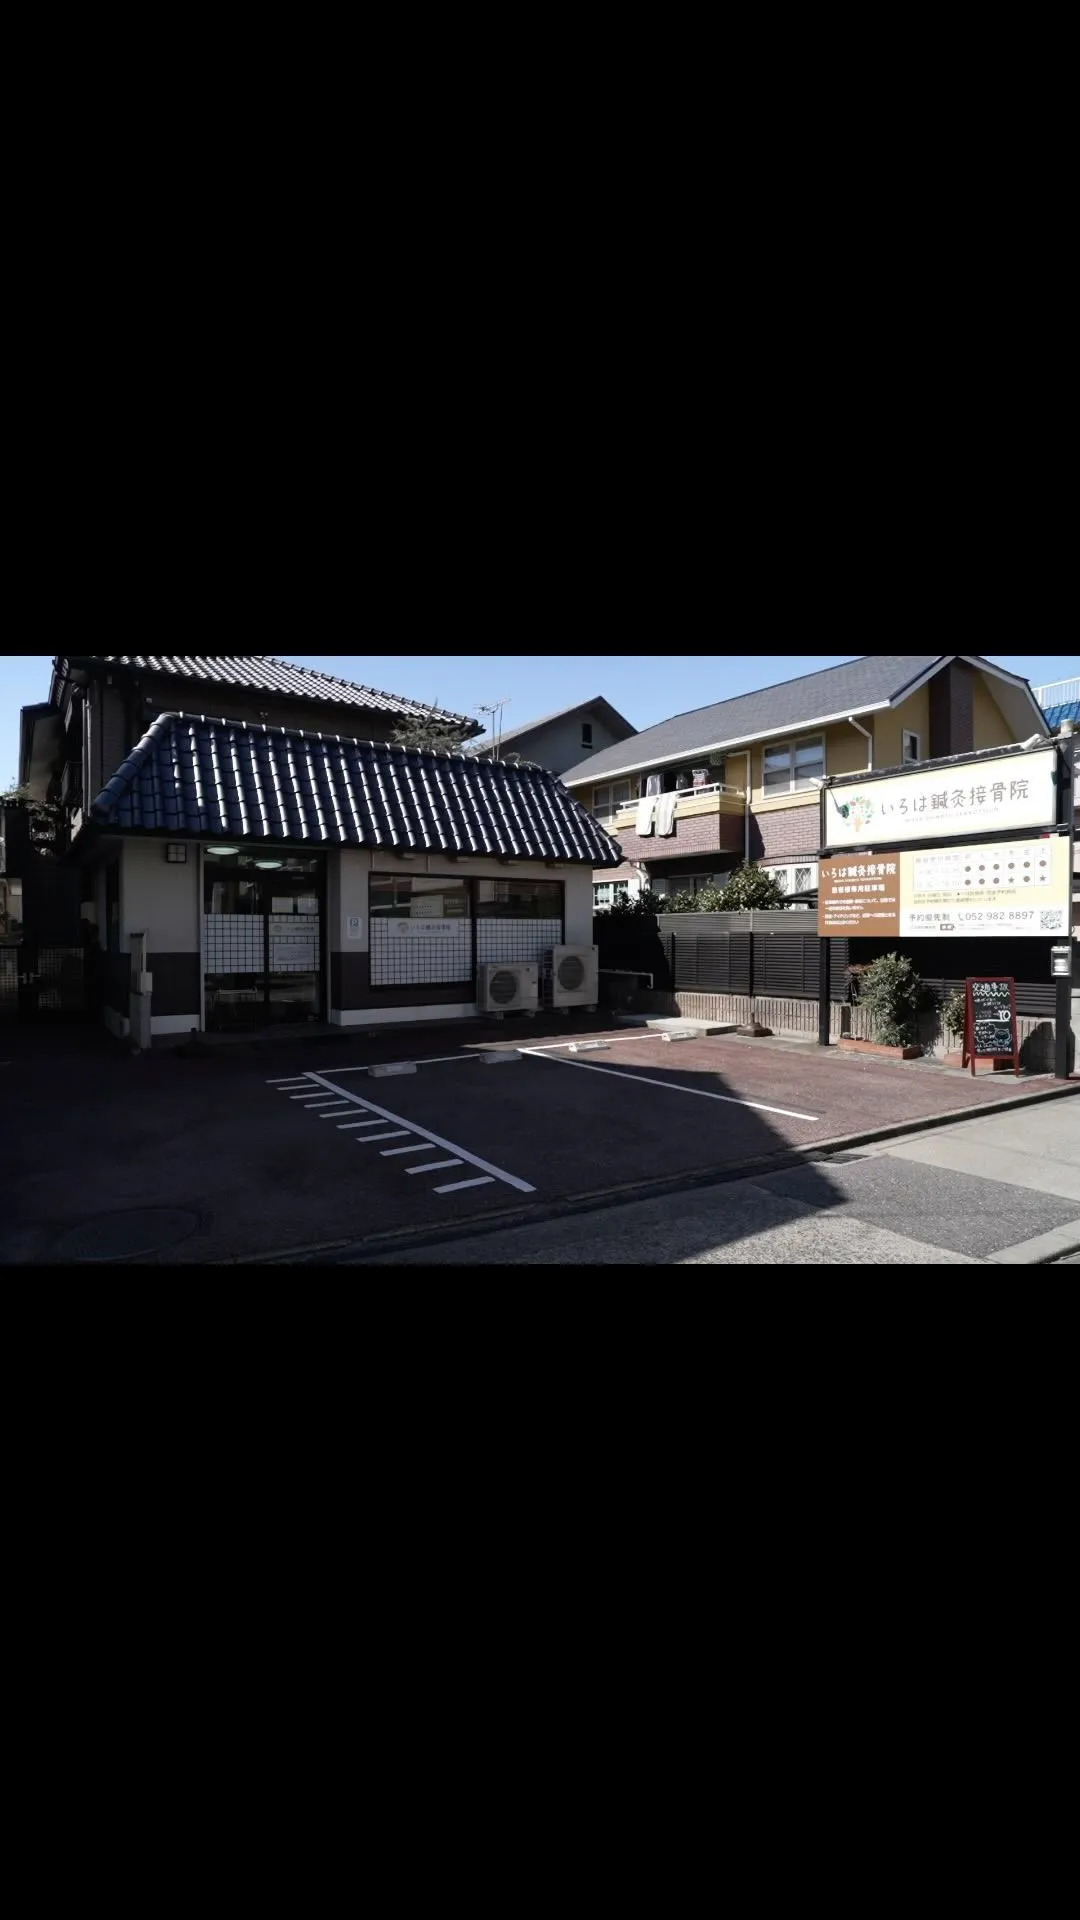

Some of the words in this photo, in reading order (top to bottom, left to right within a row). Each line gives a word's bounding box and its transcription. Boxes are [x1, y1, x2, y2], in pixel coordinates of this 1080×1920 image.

[881, 779, 1030, 816] いろは鍼灸接骨院
[965, 912, 983, 921] 052
[986, 911, 1005, 920] 982
[1008, 910, 1034, 920] 8897
